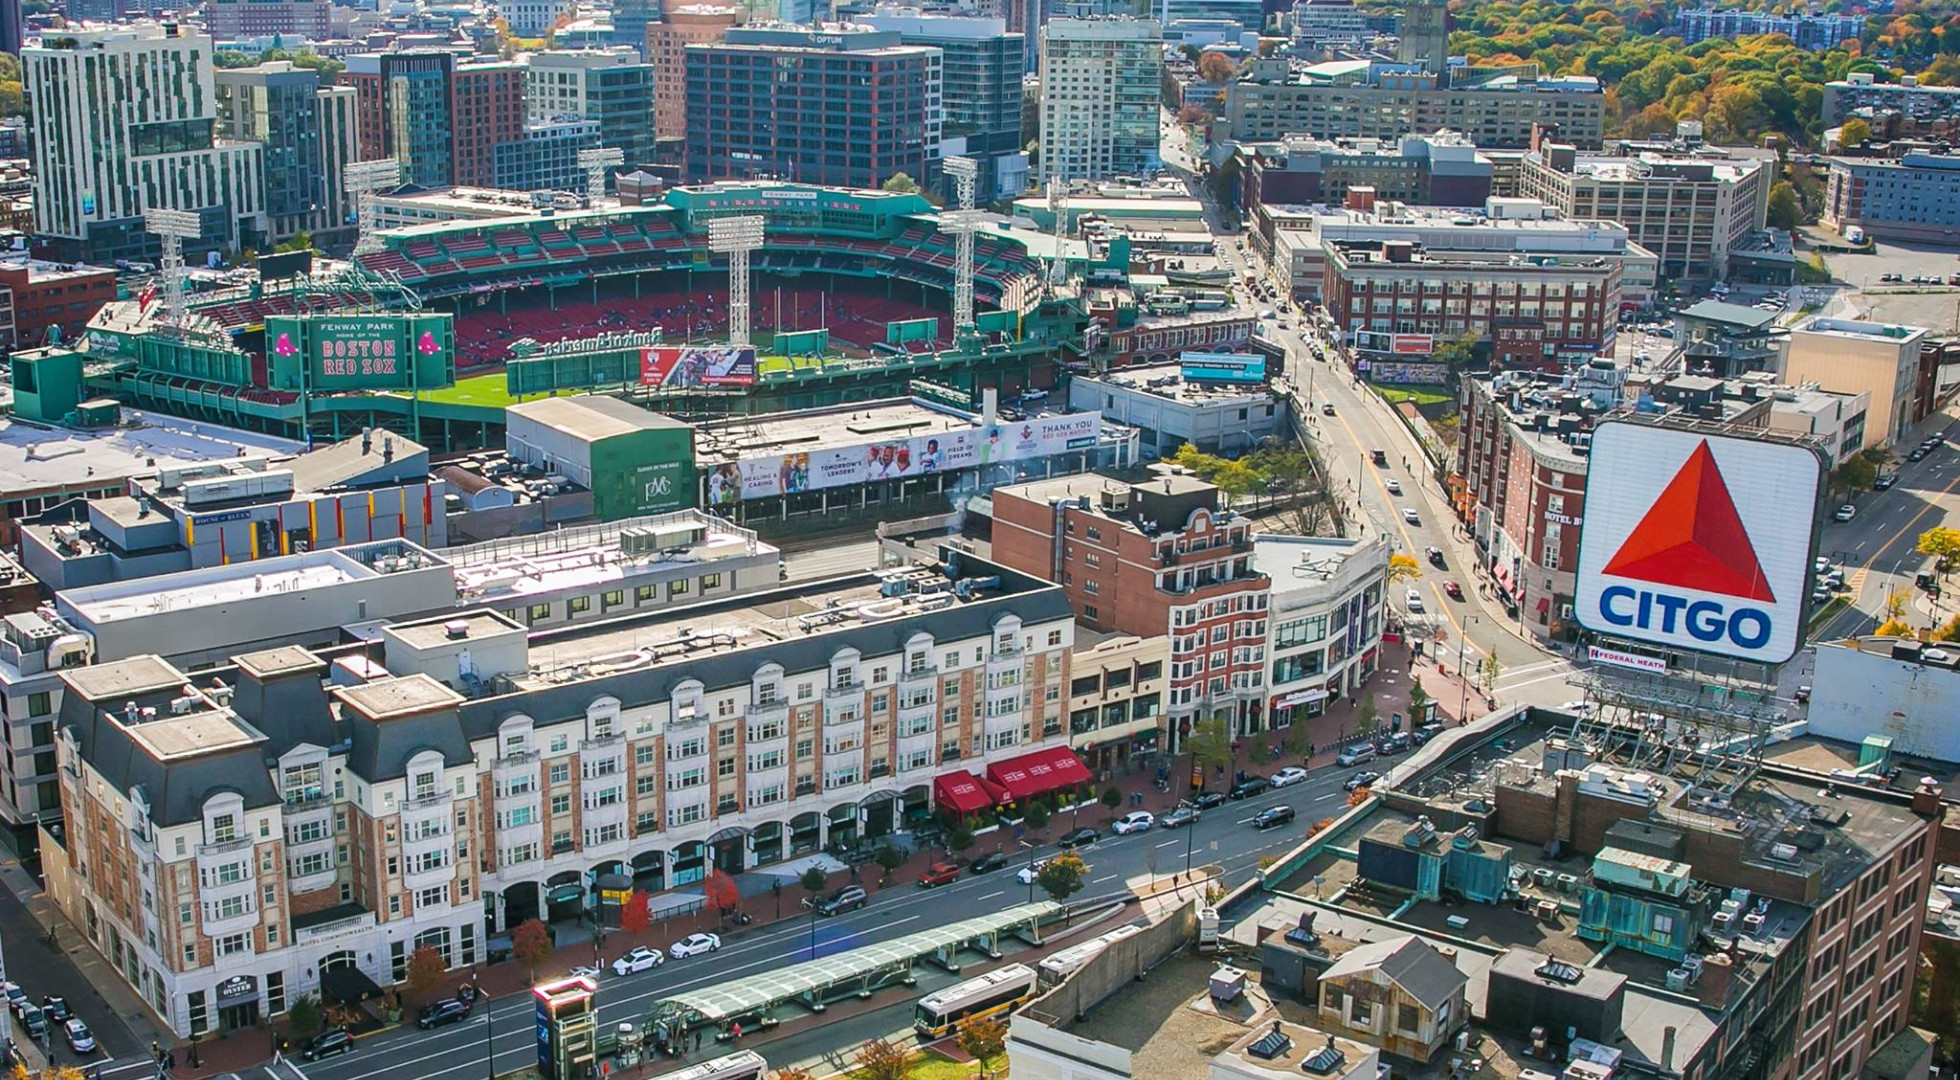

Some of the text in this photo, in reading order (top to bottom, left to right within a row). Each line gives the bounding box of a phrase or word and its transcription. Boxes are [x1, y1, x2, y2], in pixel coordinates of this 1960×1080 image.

[816, 36, 843, 44] OPTUM
[320, 323, 362, 331] FENWAY
[322, 339, 396, 357] BOSTON
[323, 358, 396, 375] RED SOX
[1042, 420, 1092, 434] THANK YOU
[947, 445, 964, 453] FIELD
[948, 451, 973, 460] DREAMS
[820, 460, 862, 472] TOMORROW'S
[744, 473, 773, 482] HEALING
[827, 468, 855, 478] LEADERS
[748, 480, 773, 488] CARING
[195, 516, 218, 524] HOUSE
[227, 512, 251, 521] BLUES
[1544, 511, 1572, 525] HOTEL
[1599, 585, 1772, 650] CITGO
[1599, 652, 1665, 670] FEDERAL HEATH
[1285, 688, 1318, 700] McDonald's
[300, 925, 374, 947] HOTEL COMMONWEALTH
[223, 983, 251, 996] OYSTER
